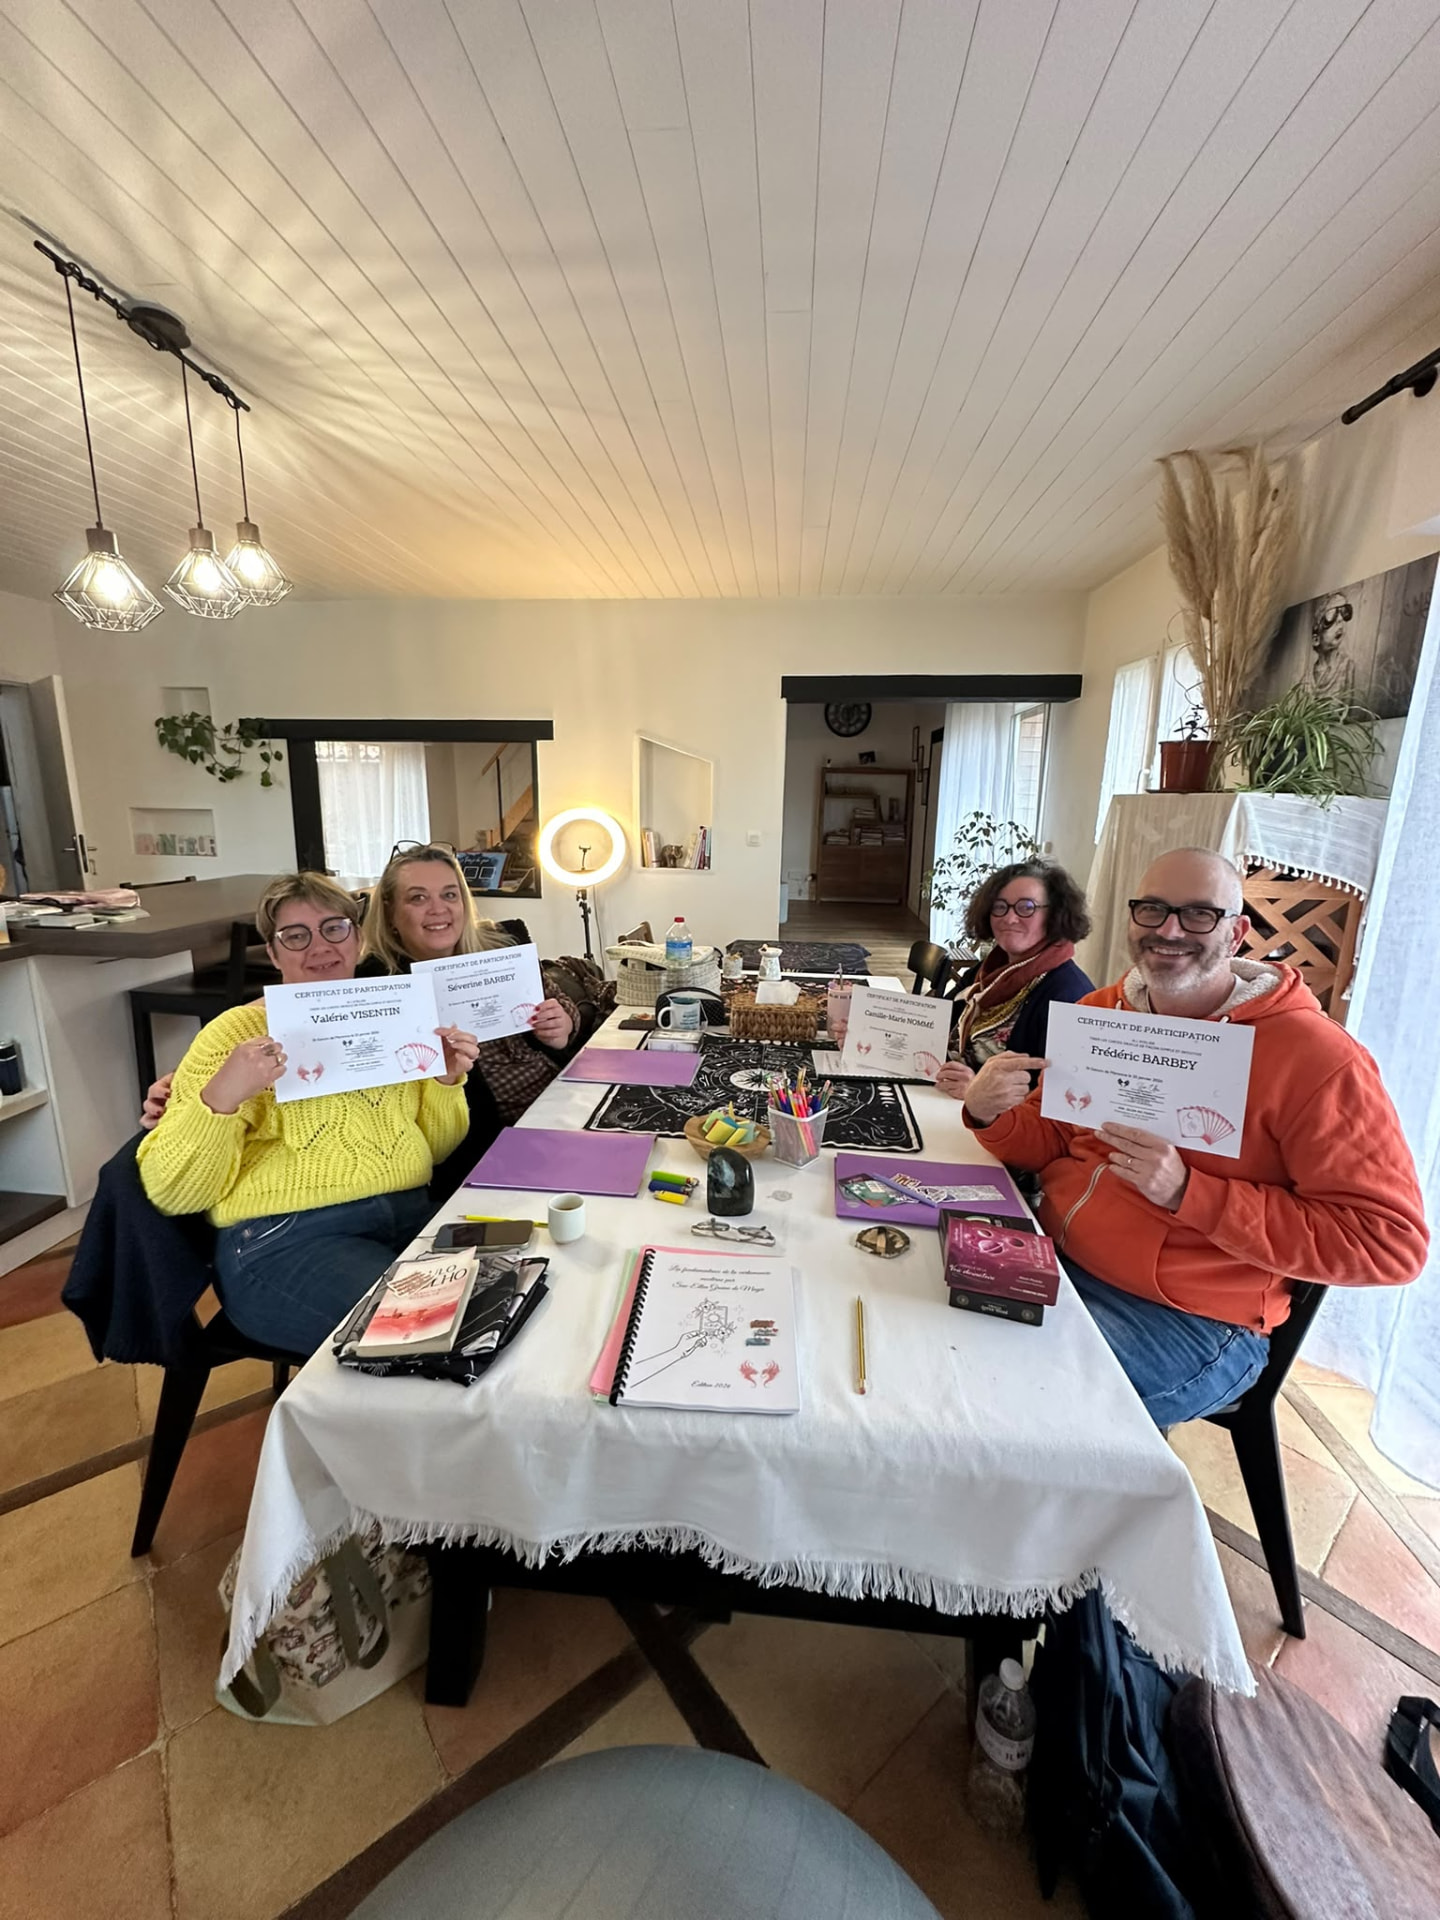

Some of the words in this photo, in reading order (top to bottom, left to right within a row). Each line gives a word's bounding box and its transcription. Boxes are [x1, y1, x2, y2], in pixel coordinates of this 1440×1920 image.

[434, 961, 469, 972] CERTIFICAT
[480, 953, 522, 965] PARTICIPATION
[295, 988, 341, 999] CERTIFICAT
[343, 987, 353, 995] DE
[355, 983, 411, 994] PARTICIPATION
[448, 980, 482, 992] Séverine
[484, 973, 516, 986] BARBEY
[310, 1013, 348, 1024] Valérie
[350, 1007, 401, 1019] VISENTIN
[1077, 1016, 1127, 1030] CERTIFICAT
[1129, 1024, 1143, 1033] DE
[1144, 1026, 1221, 1043] PARTICIPATION
[1090, 1045, 1140, 1062] Frédéric
[1142, 1053, 1198, 1071] BARBEY
